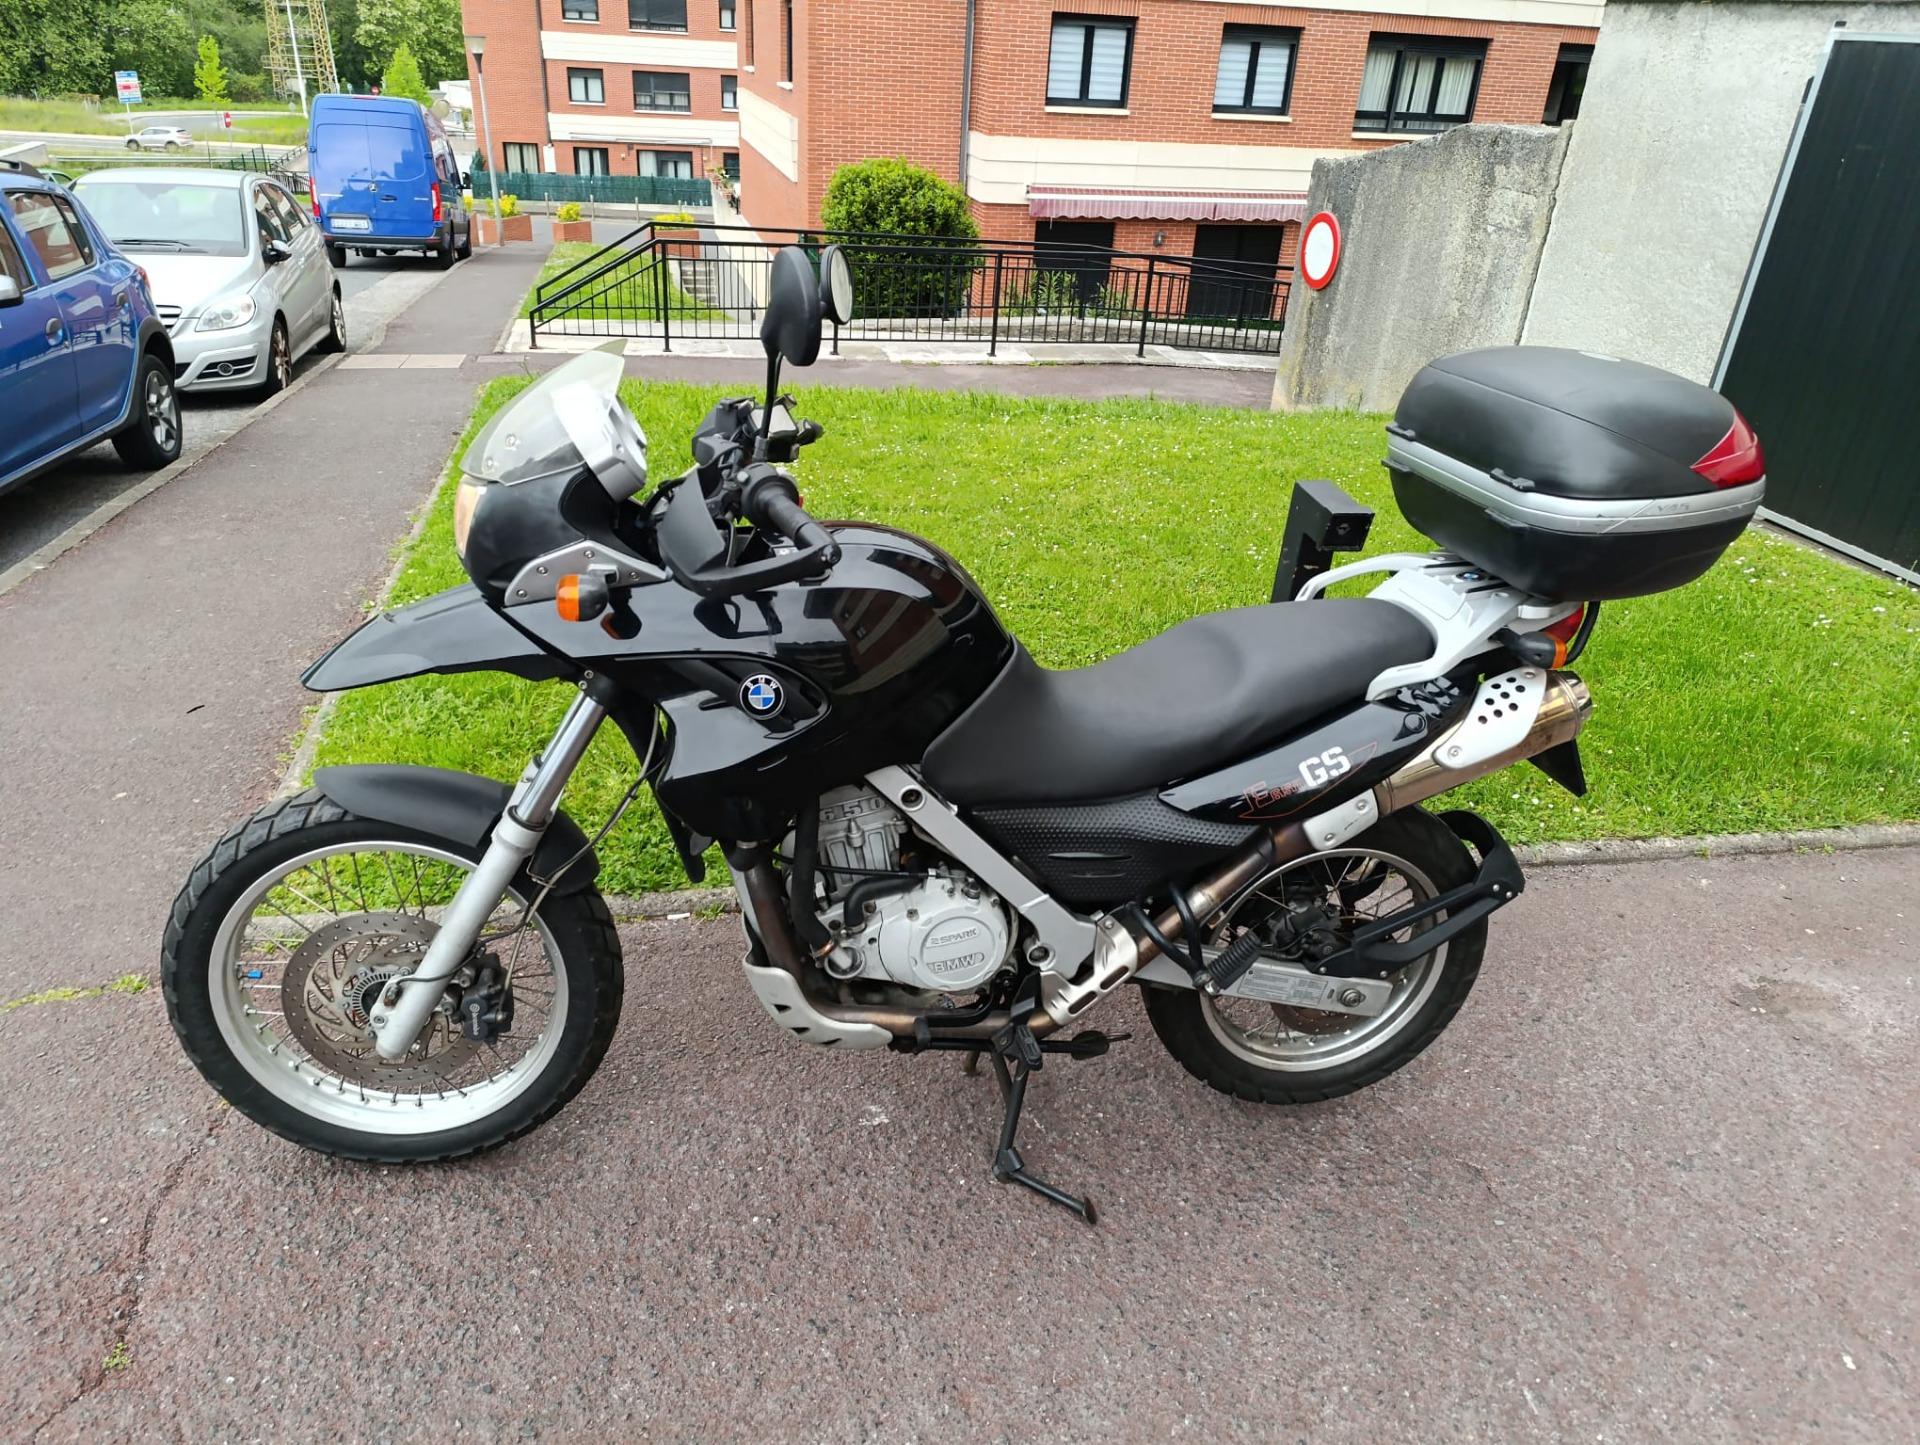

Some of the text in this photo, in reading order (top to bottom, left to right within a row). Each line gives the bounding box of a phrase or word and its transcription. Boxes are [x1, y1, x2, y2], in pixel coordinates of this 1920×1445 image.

[746, 676, 779, 690] BMW
[1298, 746, 1352, 787] GS
[819, 797, 885, 821] 650
[939, 928, 977, 943] SPARK
[935, 953, 975, 972] BMW
